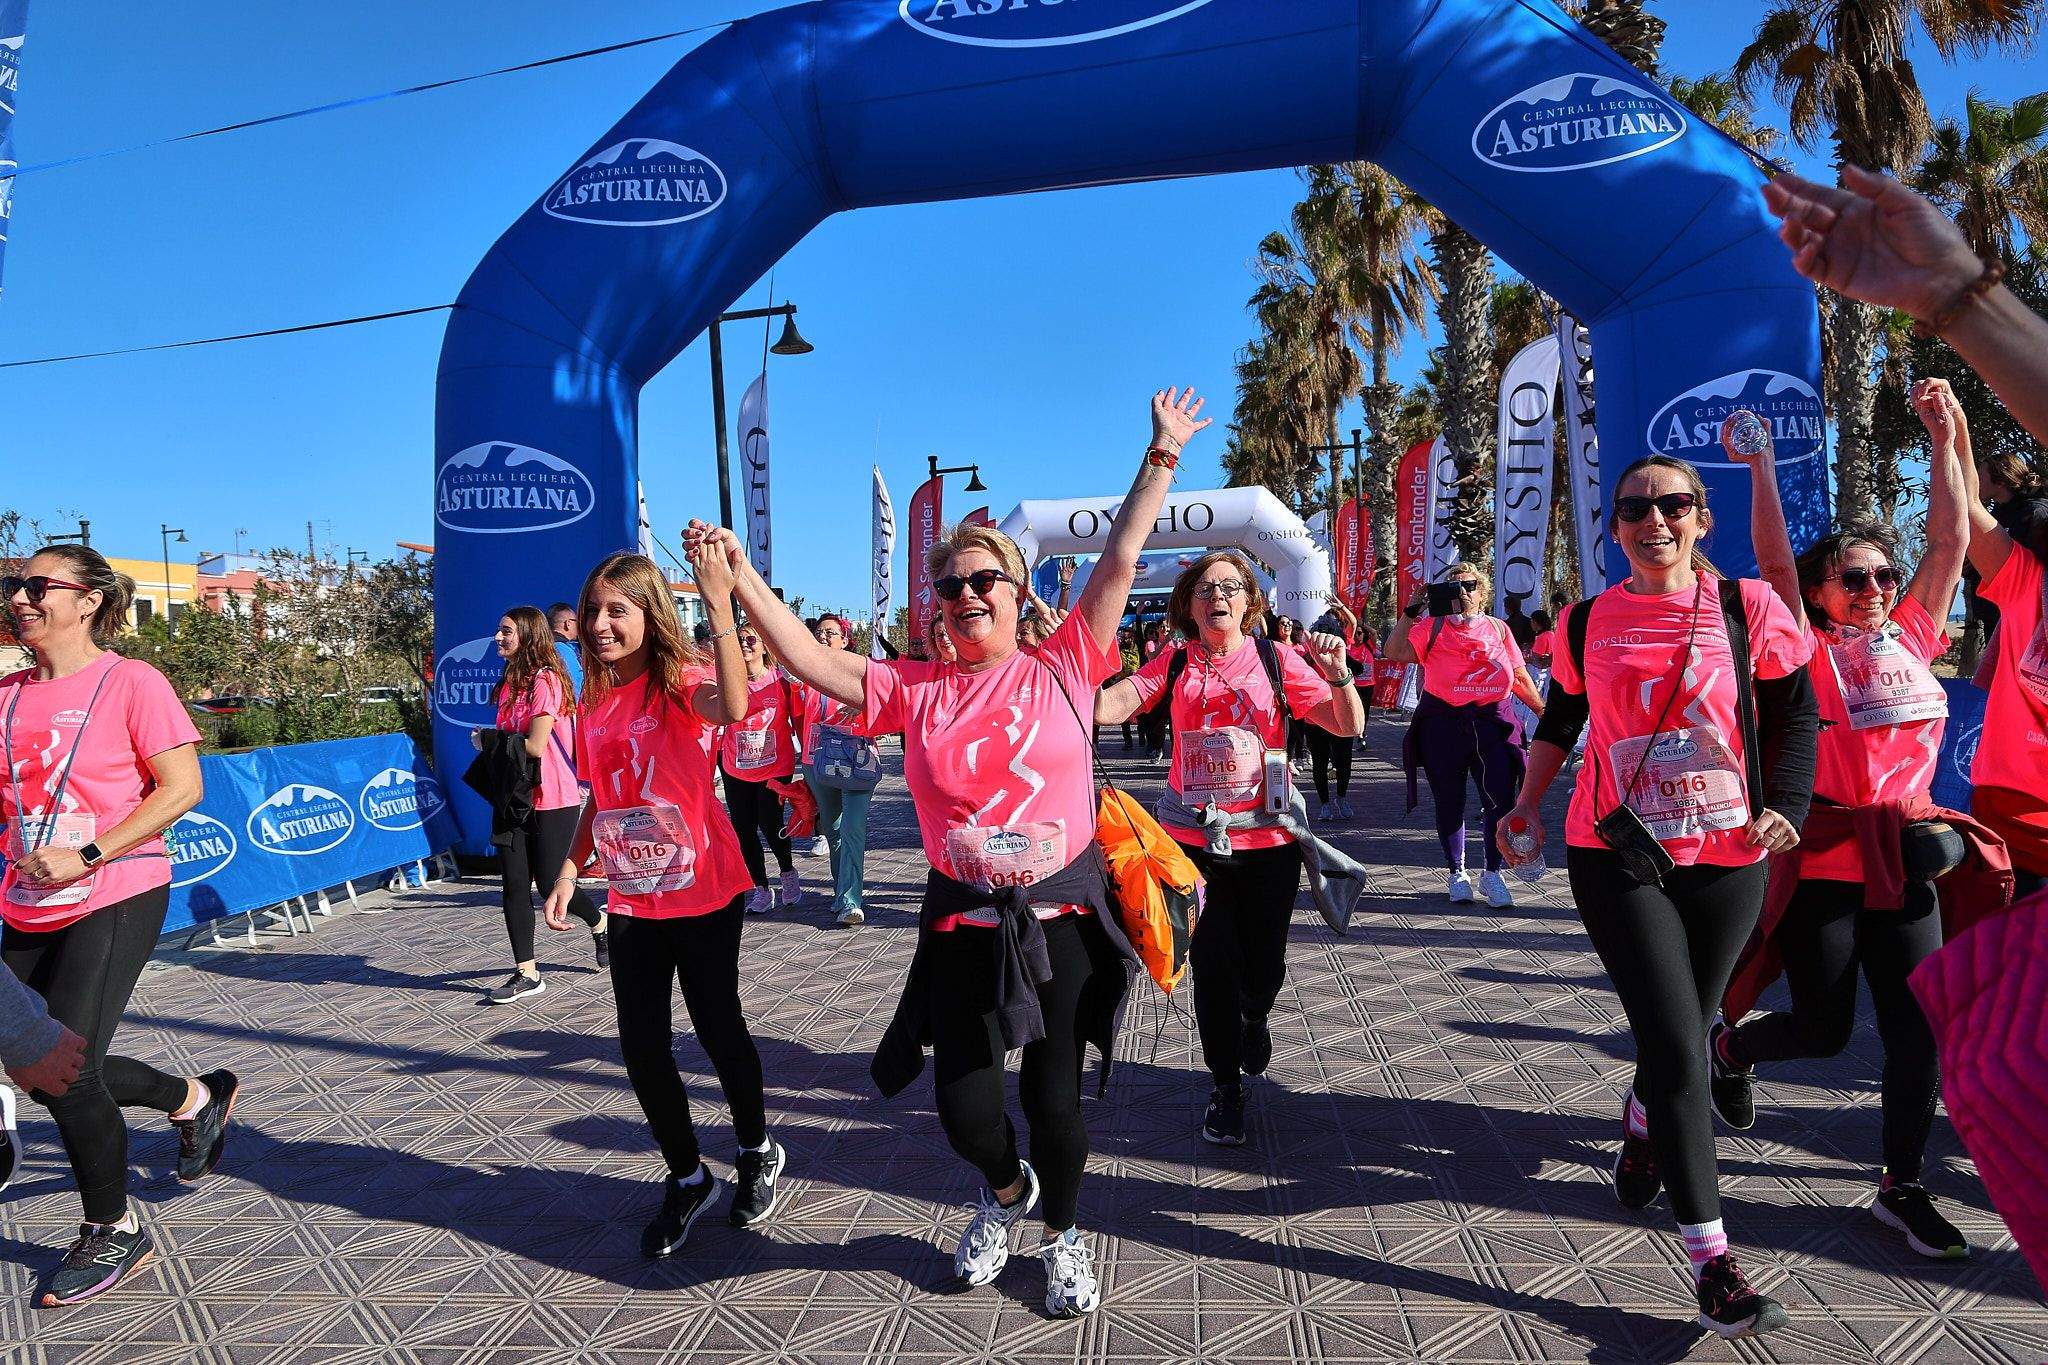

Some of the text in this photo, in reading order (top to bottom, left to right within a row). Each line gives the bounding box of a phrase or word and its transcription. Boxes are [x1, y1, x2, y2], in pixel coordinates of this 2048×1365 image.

[1522, 100, 1662, 122] CENTRAL LECHERA
[1489, 112, 1677, 157] ASTURIANA
[581, 164, 705, 181] CENTRAL LECHERA
[550, 177, 713, 210] ASTURIANA
[1662, 413, 1823, 451] ASTIANA
[452, 472, 576, 485] CENTRAL LECHERA
[437, 479, 582, 514] ASTURIANA
[1502, 381, 1549, 600] OYSHO
[1408, 466, 1427, 556] Santander
[1068, 502, 1215, 539] OHO
[1257, 529, 1303, 541] OYSHO
[1346, 516, 1358, 580] Santander
[1361, 523, 1374, 577] Santan
[1285, 589, 1327, 601] OYSHO
[1592, 633, 1642, 650] OYSHO
[451, 668, 502, 678] CENTRAL
[1879, 669, 1916, 687] 016
[1863, 709, 1899, 721] OYSHO
[1651, 746, 1696, 759] ASTURIANA
[1206, 760, 1237, 774] 016
[1660, 775, 1707, 797] 016
[368, 790, 442, 820] ASTURIANA
[1673, 798, 1696, 808] 3982
[1706, 801, 1733, 812] VALENCIA
[260, 810, 351, 845] ASTURIANA
[1702, 815, 1737, 826] Santander
[629, 842, 667, 860] 016
[986, 840, 1028, 851] ASTURIANA
[991, 869, 1034, 887] 016
